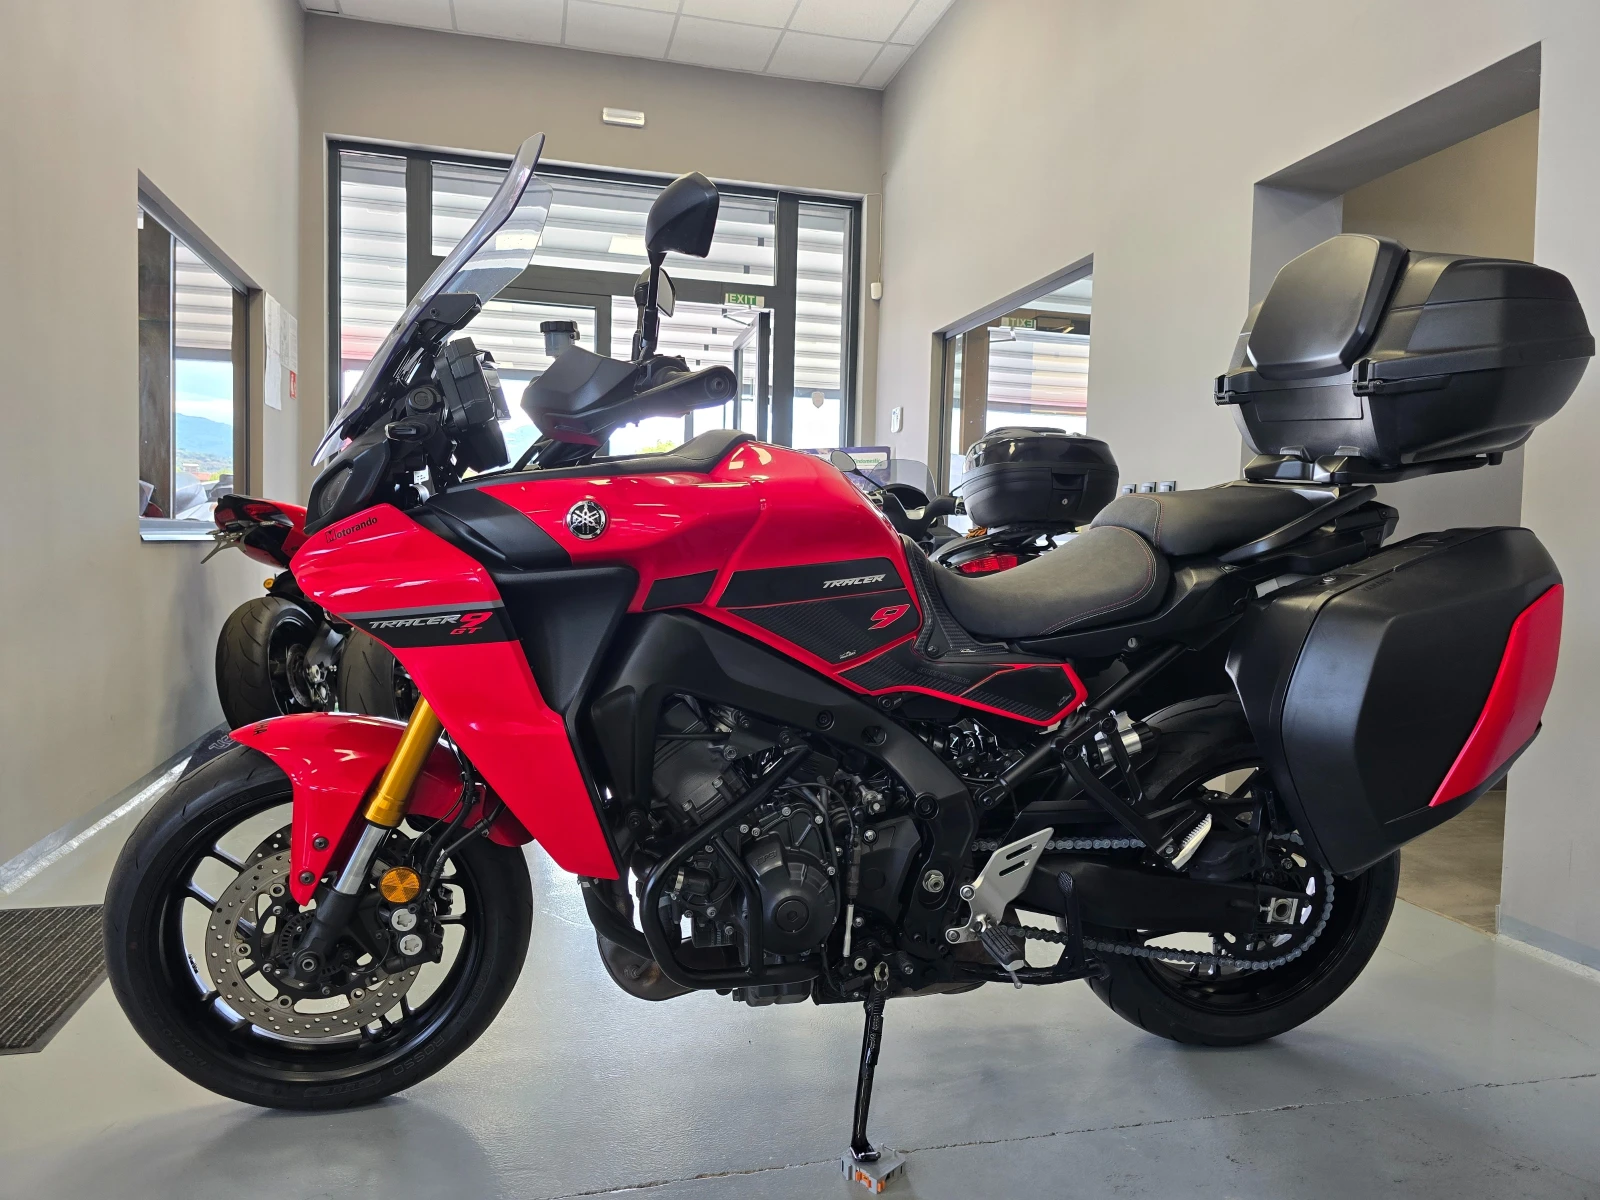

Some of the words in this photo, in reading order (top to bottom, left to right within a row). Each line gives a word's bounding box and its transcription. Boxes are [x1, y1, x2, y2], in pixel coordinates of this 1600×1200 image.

[729, 293, 755, 305] EXIT
[325, 516, 378, 544] Motorando
[823, 574, 886, 589] TRACER
[369, 614, 461, 629] TRACER
[460, 611, 493, 628] 9
[868, 603, 910, 630] 9
[450, 626, 482, 635] GT
[392, 1035, 445, 1076] ROSSO
